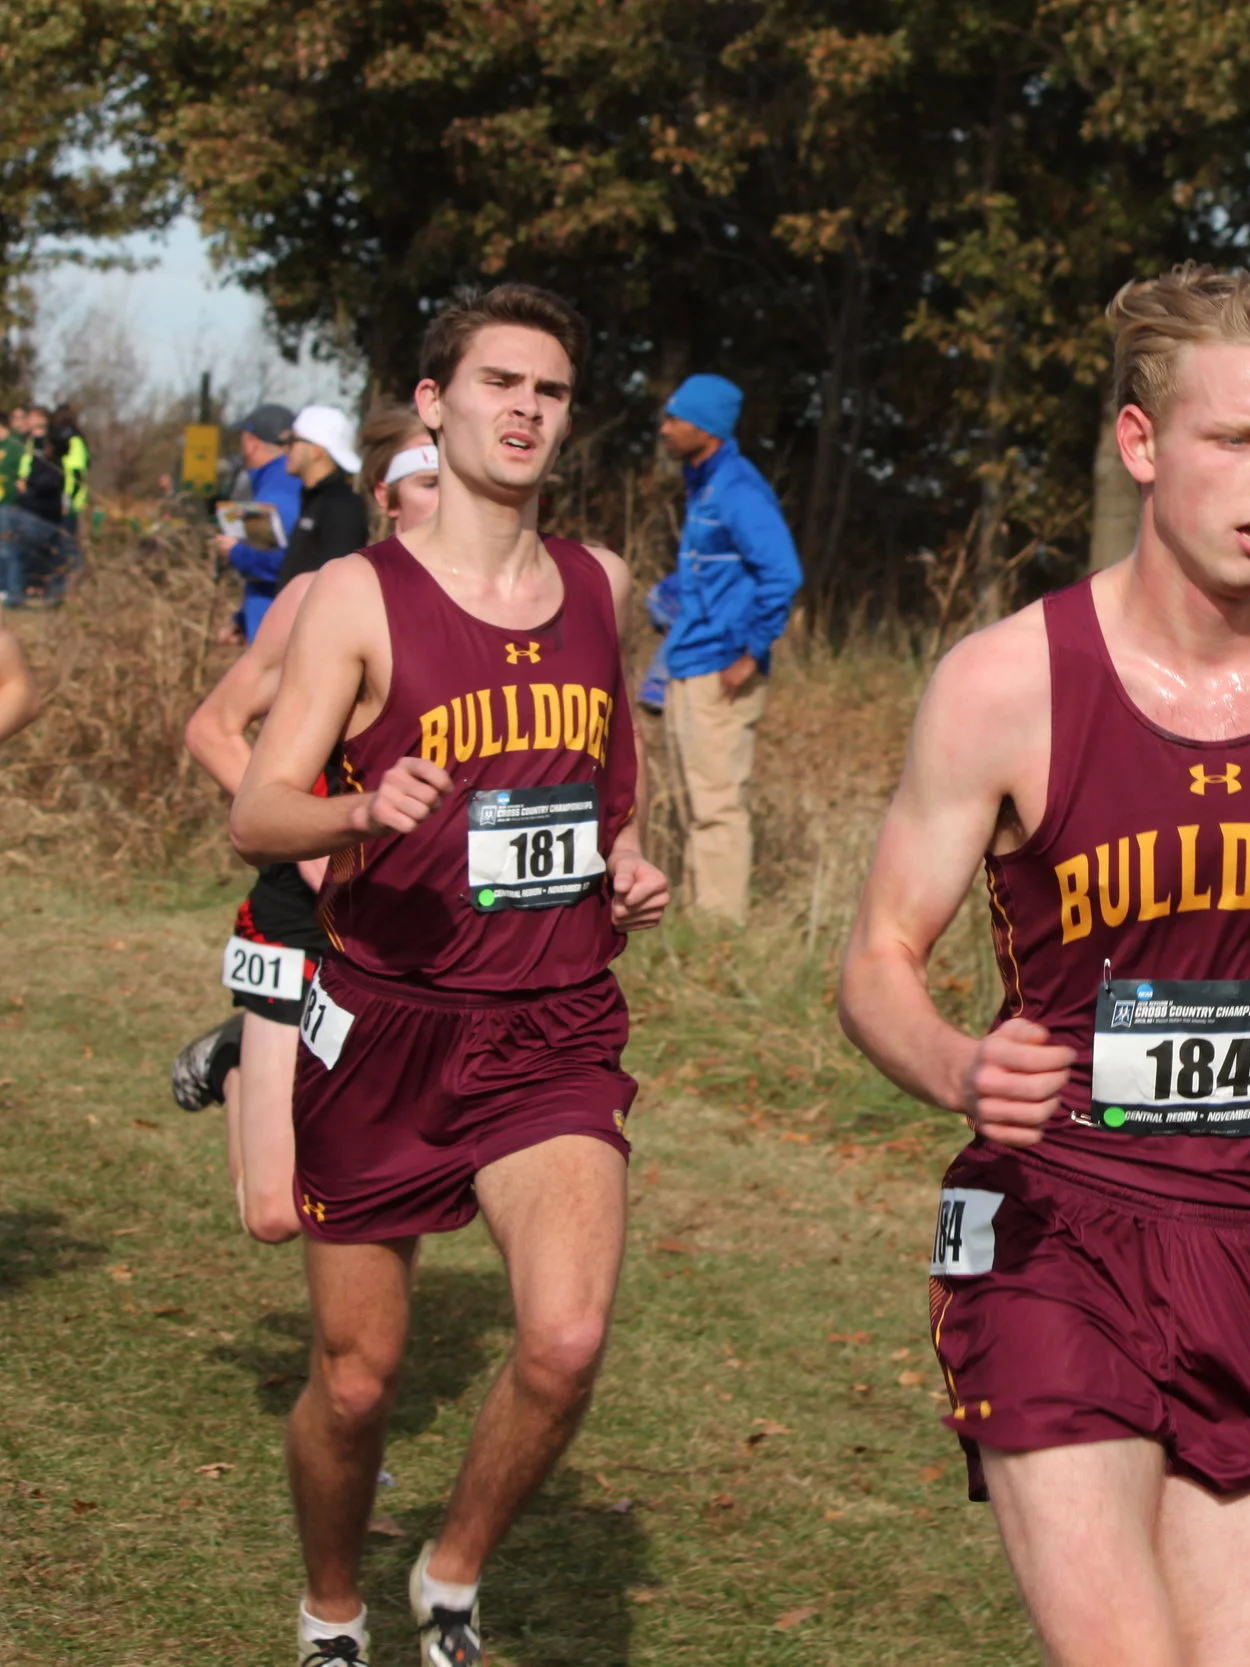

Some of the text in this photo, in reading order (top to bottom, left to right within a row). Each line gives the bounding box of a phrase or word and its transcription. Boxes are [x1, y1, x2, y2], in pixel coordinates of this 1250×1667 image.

[509, 828, 575, 880] 181
[231, 948, 282, 989] 201
[1134, 1005, 1168, 1018] CROSS
[1168, 1005, 1215, 1018] COUNTRY
[1124, 1110, 1163, 1123] CENTRAL
[1166, 1111, 1198, 1123] REGION
